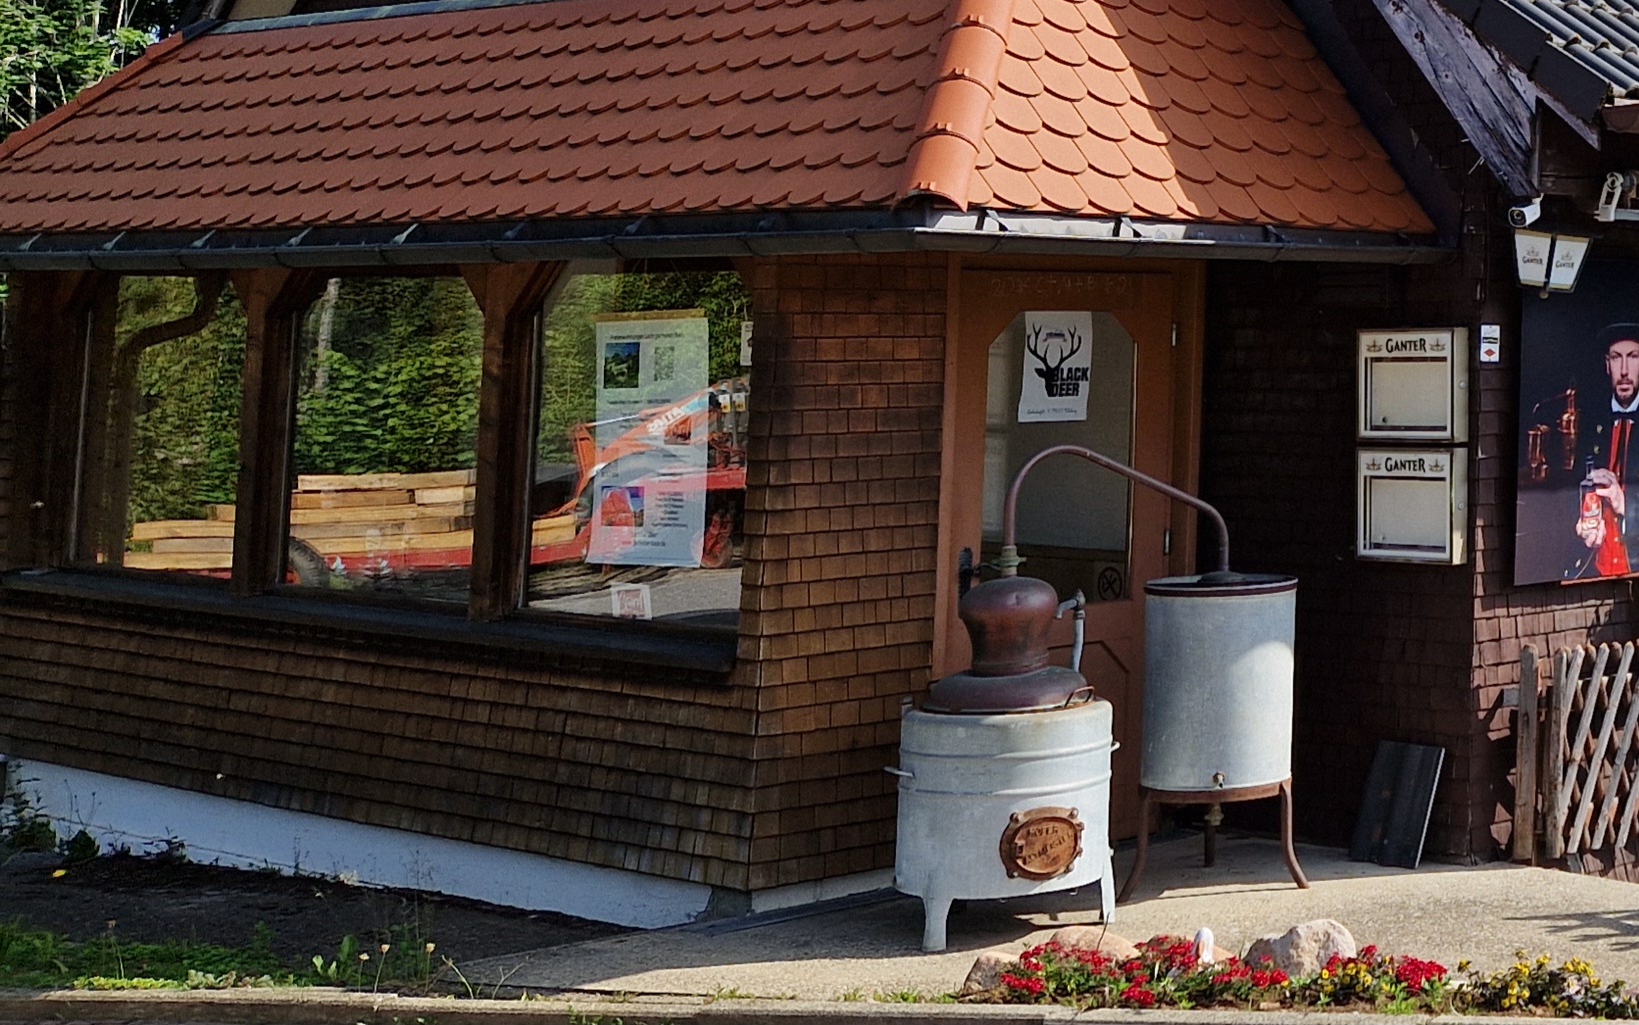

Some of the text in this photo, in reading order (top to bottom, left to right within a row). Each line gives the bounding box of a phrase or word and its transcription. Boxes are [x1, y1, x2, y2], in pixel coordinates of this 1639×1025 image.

[1522, 256, 1543, 265] GANTER
[1385, 338, 1427, 353] GANTER
[1052, 367, 1089, 382] BLACK
[1050, 383, 1080, 397] DEER
[1384, 457, 1426, 473] GANTER
